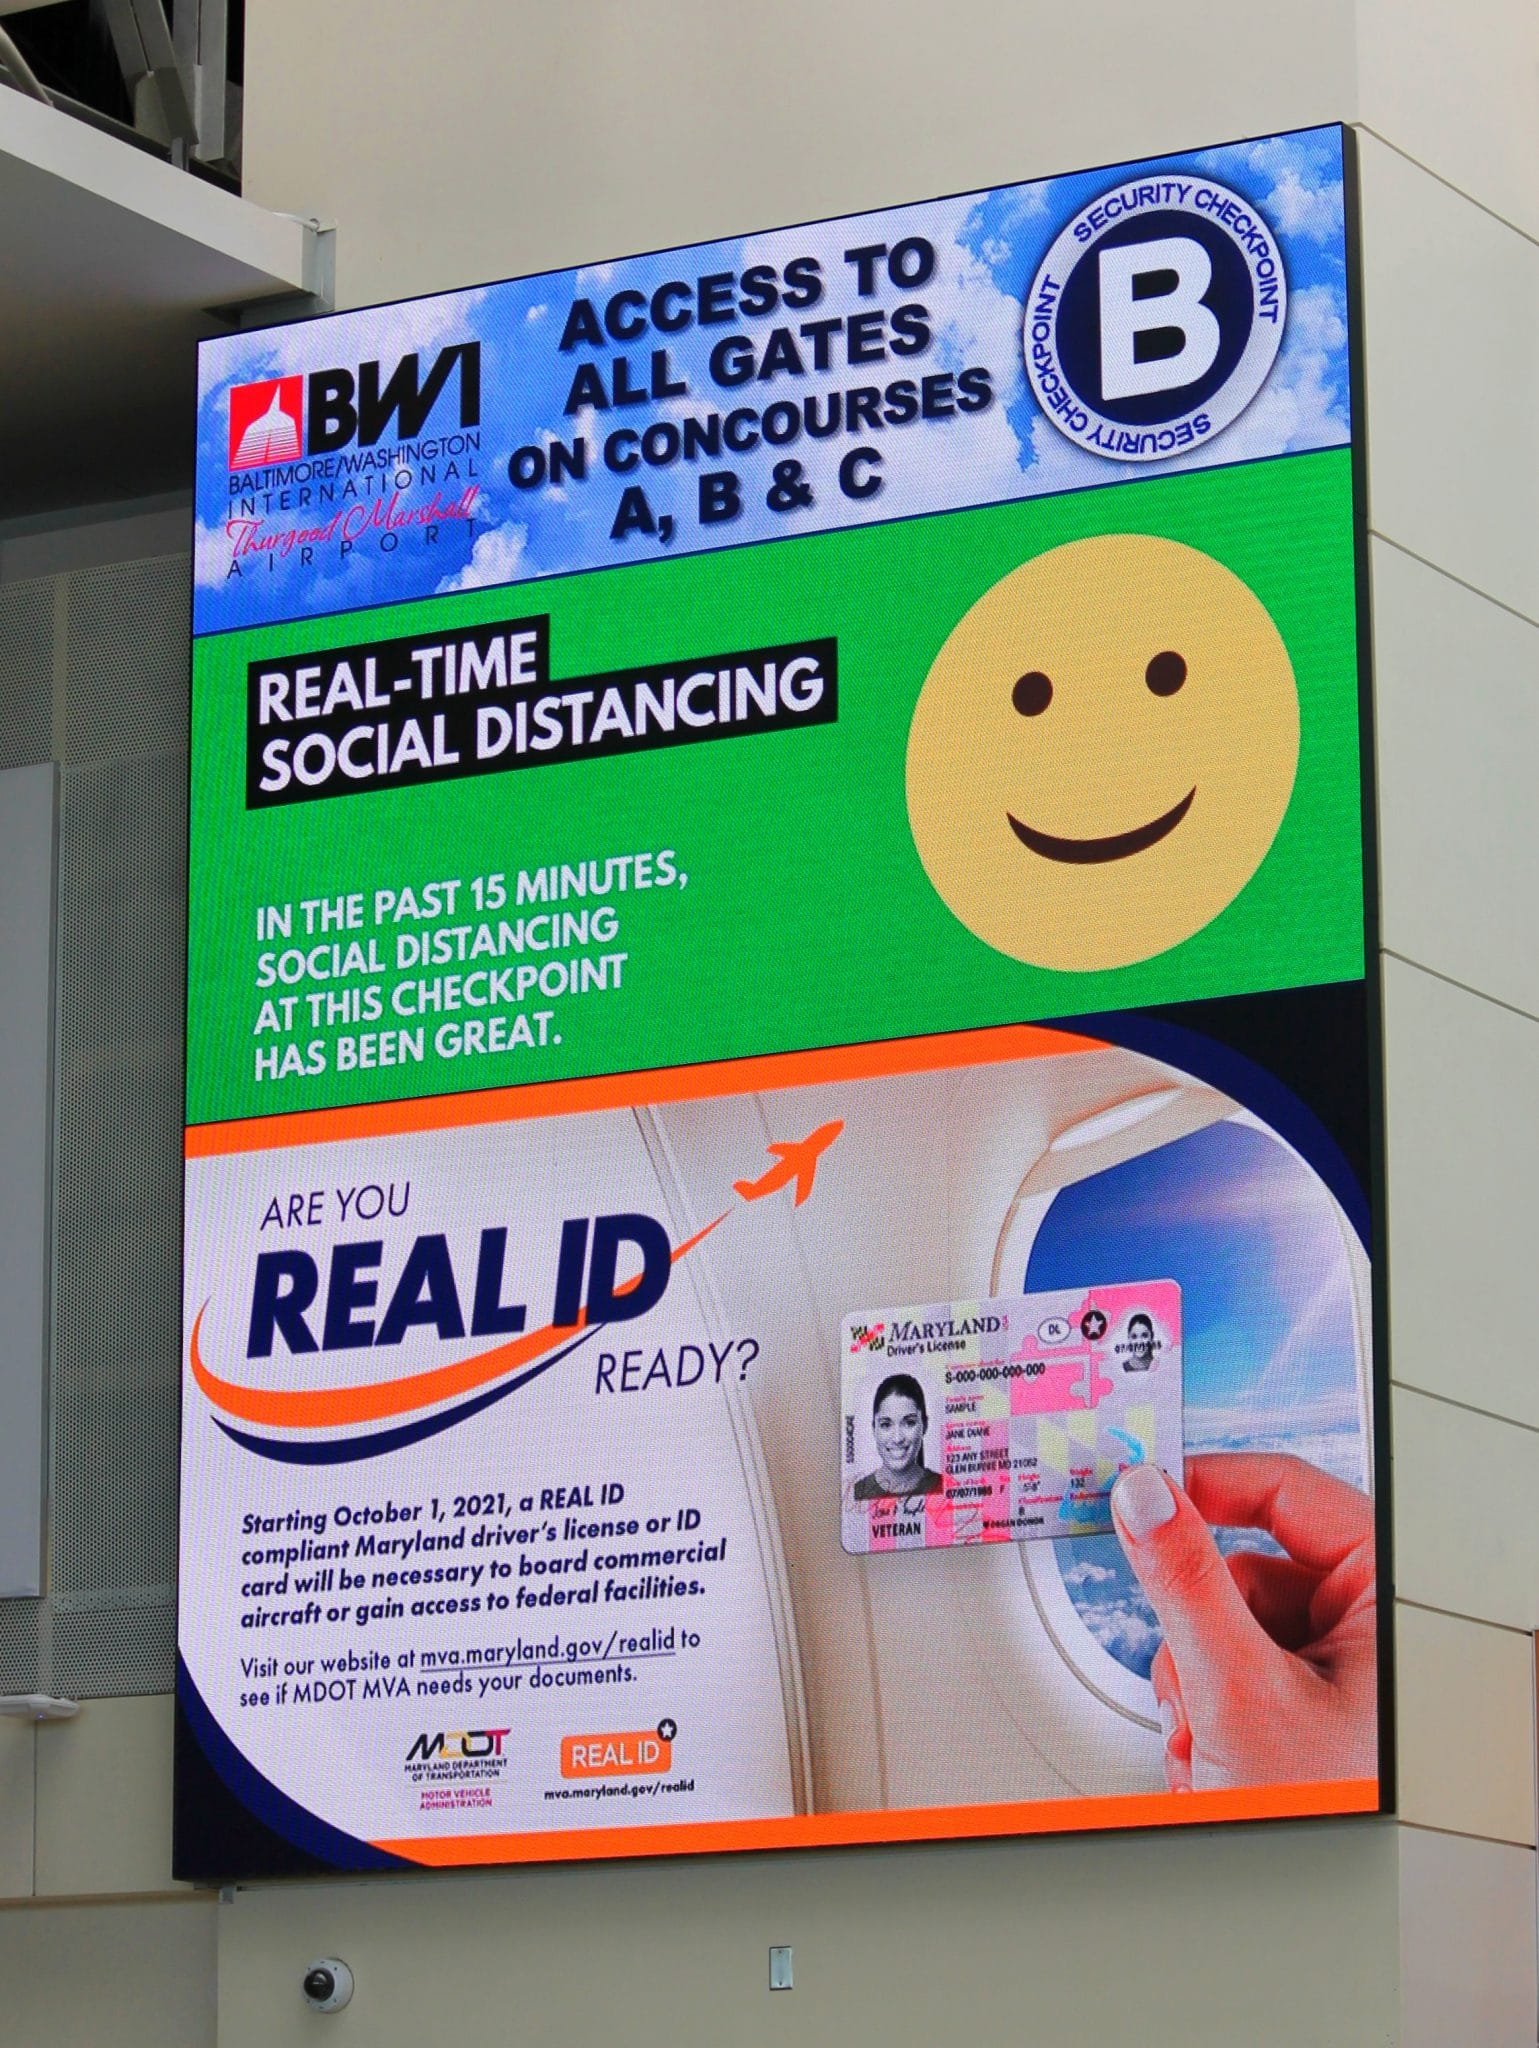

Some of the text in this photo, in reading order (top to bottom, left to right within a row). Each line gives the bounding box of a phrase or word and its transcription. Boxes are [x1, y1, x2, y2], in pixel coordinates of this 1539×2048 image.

[1074, 183, 1278, 323] SECURITY CHECKPOINT
[559, 237, 936, 351] ACCESS TO
[1099, 237, 1220, 401] B
[563, 305, 930, 415] ALL GATES
[1032, 275, 1211, 454] SECURITY CHECKPOINT
[308, 341, 481, 455] BWI
[508, 367, 993, 490] ON CONCOURSES
[228, 459, 478, 519] INTERNATIONAL
[229, 432, 480, 495] BALTIMORE/WASHINGTON
[226, 484, 480, 558] Thurgood Marshall
[610, 447, 883, 542] A, B & C
[227, 518, 477, 579] AIRPORT
[258, 631, 537, 724] REAL-TIME
[259, 657, 824, 791] SOCIAL DISTANCING
[256, 850, 688, 940] IN THE PAST 15 MINUTES,
[256, 907, 619, 987] SOCIAL DISTANCING
[253, 953, 628, 1034] AT THIS CHECKPOINT
[254, 1011, 562, 1081] HAS BEEN GREAT.
[260, 1181, 410, 1231] ARE YOU
[246, 1213, 672, 1359] REAL ID
[887, 1339, 966, 1357] Driver's License
[889, 1316, 1000, 1342] MARYLAND
[595, 1338, 760, 1394] READY?
[241, 1508, 701, 1569] compliant Maryland driver's license or ID
[242, 1483, 625, 1536] Starting October 1, 2021, a REAL ID
[872, 1523, 921, 1538] VETERAN
[241, 1537, 726, 1598] card will be necessary to board commercial
[240, 1575, 706, 1628] aircraft or gain access to federal facilities.
[240, 1627, 701, 1677] Visit our website at mva.maryland.gov/realid to
[240, 1662, 637, 1707] see if MDOT MVA needs your documents.
[404, 1758, 507, 1772] MARYLAND DEPARTMENT
[412, 1769, 500, 1782] OF TRANSPORTATION
[571, 1741, 659, 1768] REAL ID
[420, 1799, 492, 1811] ADMINISTRATION
[421, 1788, 491, 1800] MOTOR VEHICLE
[544, 1779, 695, 1801] mva.maryland.gov/realid
